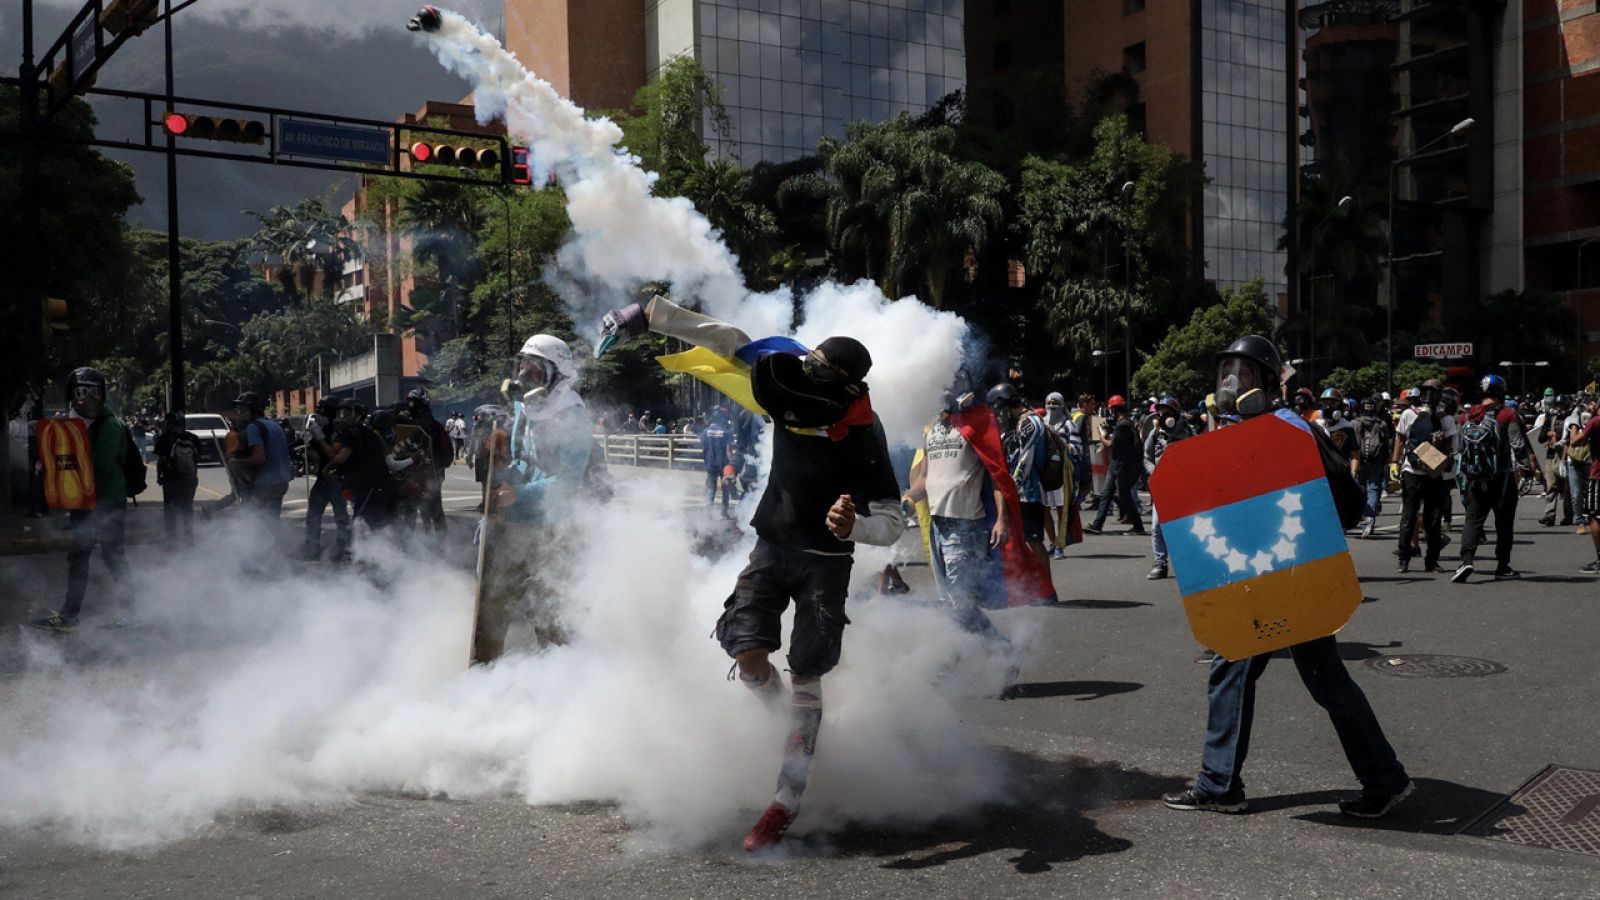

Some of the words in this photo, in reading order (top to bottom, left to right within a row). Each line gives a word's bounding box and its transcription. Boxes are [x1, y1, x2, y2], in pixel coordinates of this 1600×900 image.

[297, 133, 340, 149] FRANCISCO
[341, 139, 351, 149] DE
[352, 139, 385, 152] MIRANDA
[1416, 344, 1471, 355] EDICAMPO
